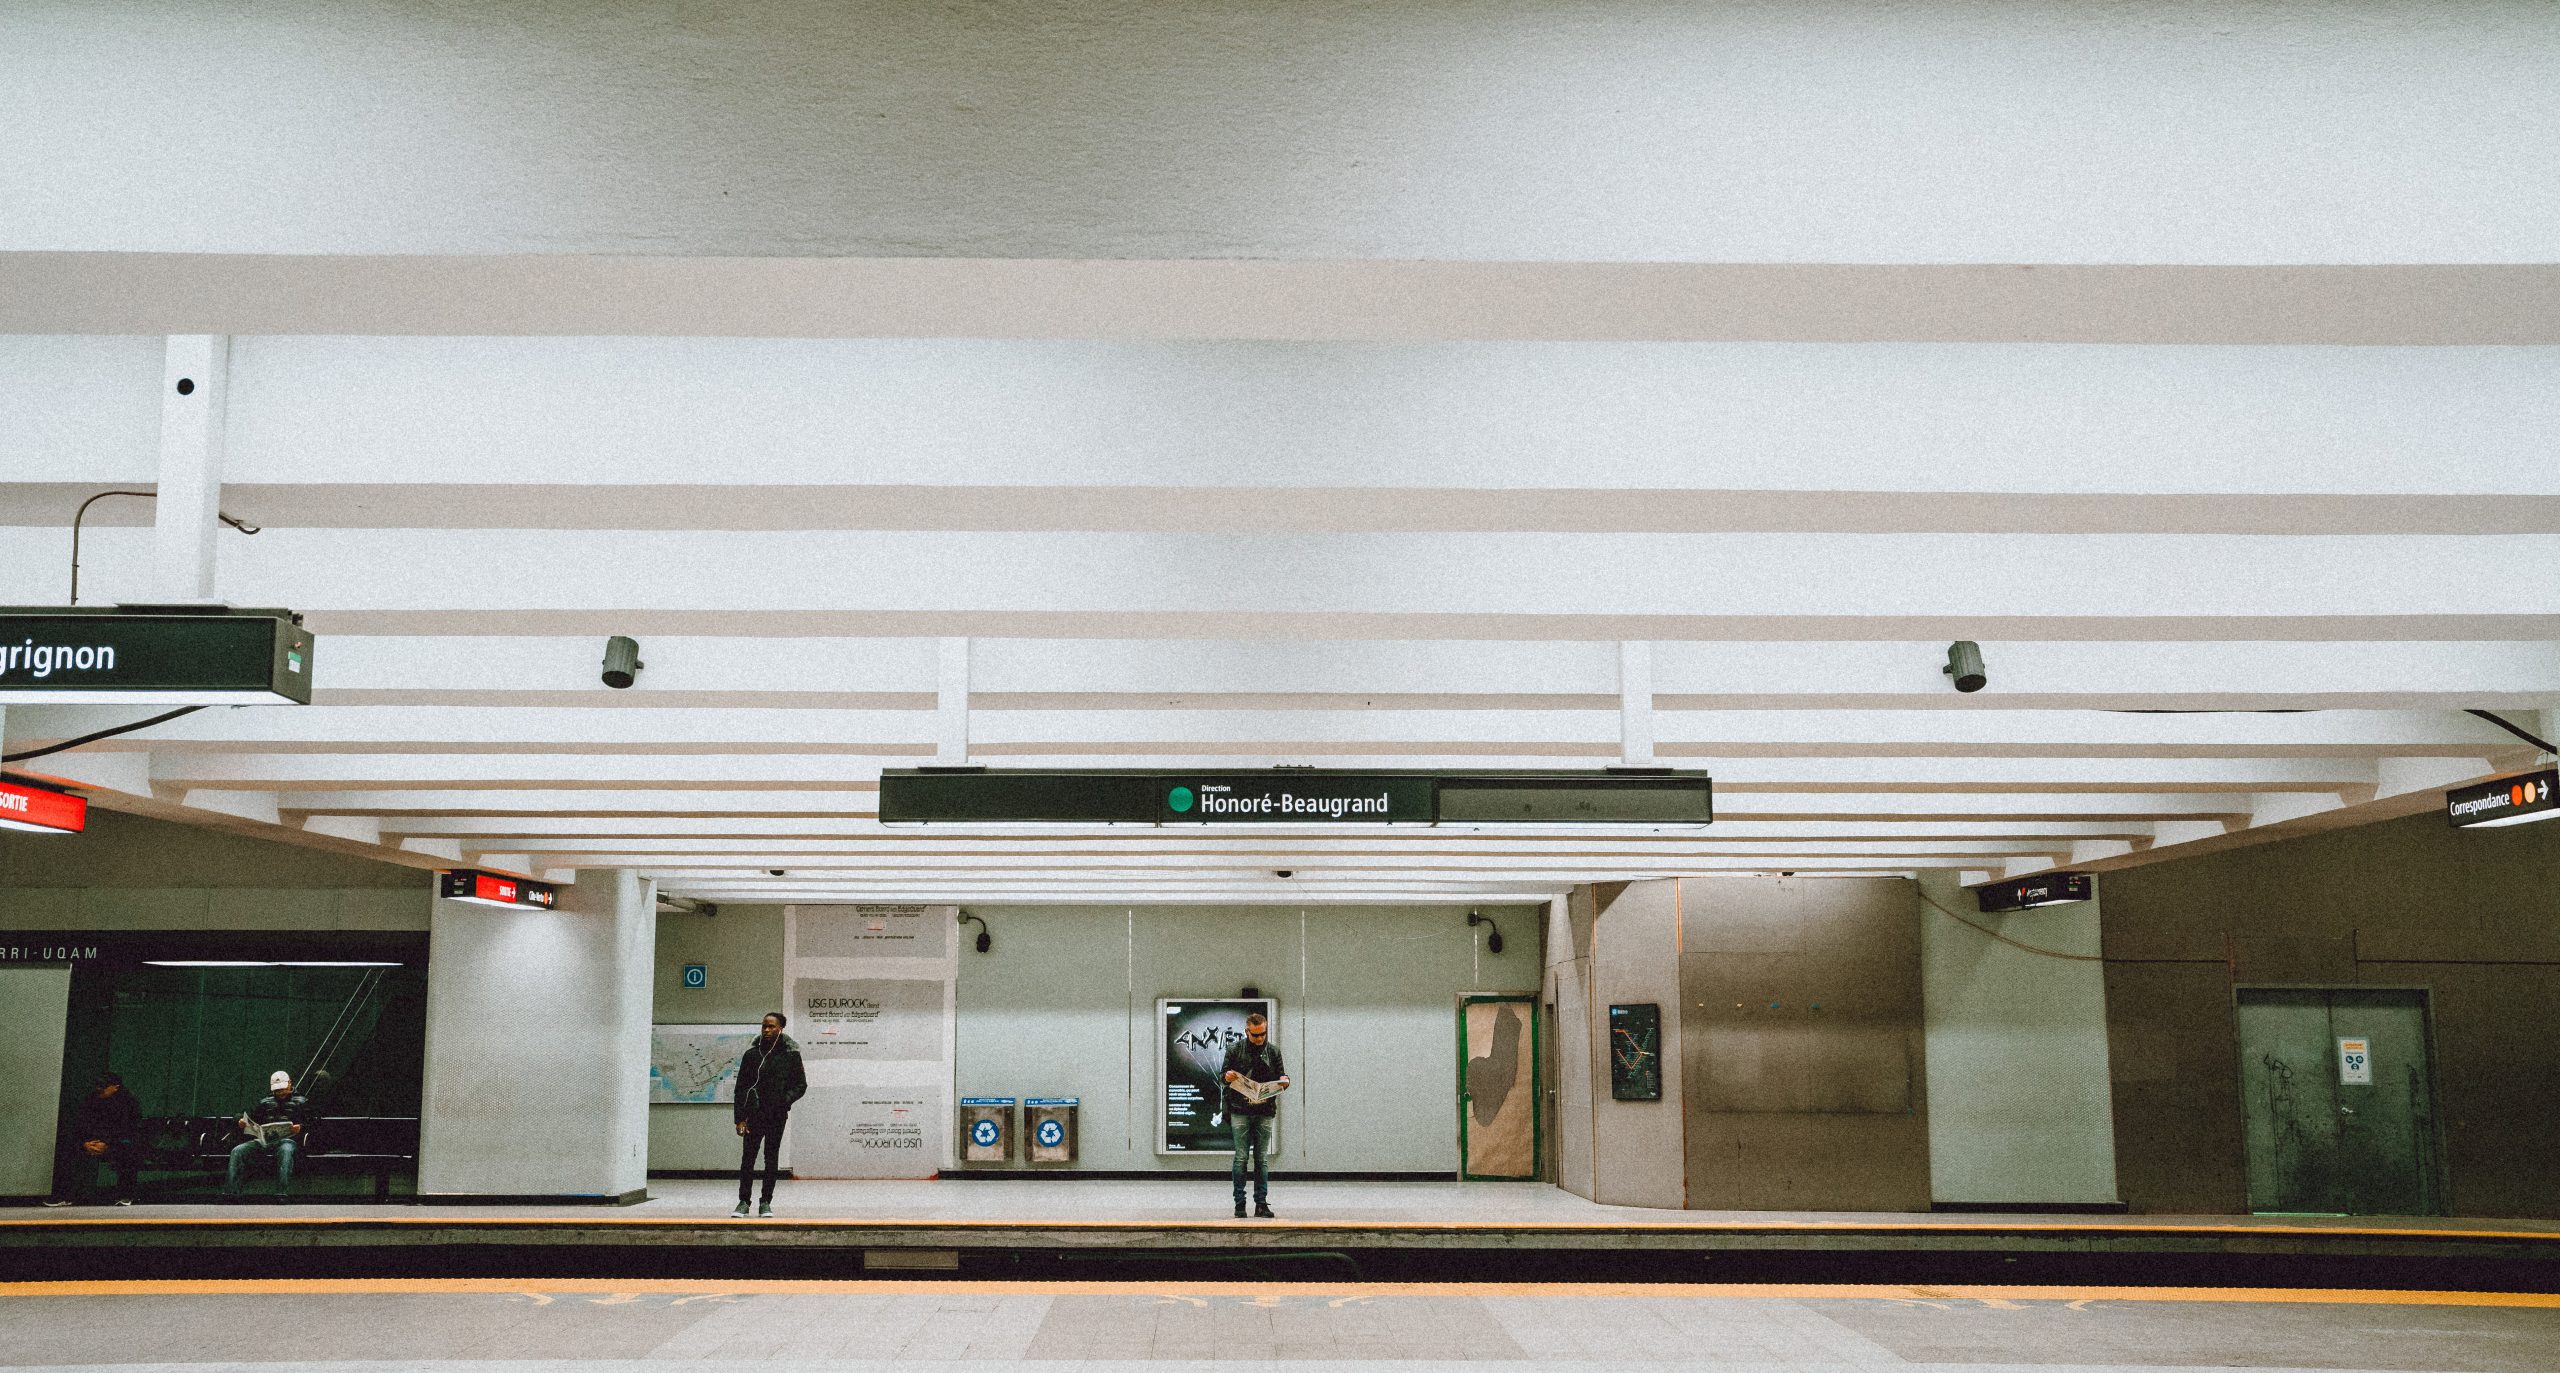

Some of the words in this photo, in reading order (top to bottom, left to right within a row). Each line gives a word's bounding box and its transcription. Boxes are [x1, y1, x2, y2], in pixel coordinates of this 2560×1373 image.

[1201, 793, 1388, 817] Honoré-Beaugrand
[2450, 793, 2510, 816] Correspondance
[808, 999, 827, 1009] USG
[903, 1138, 922, 1148] USG
